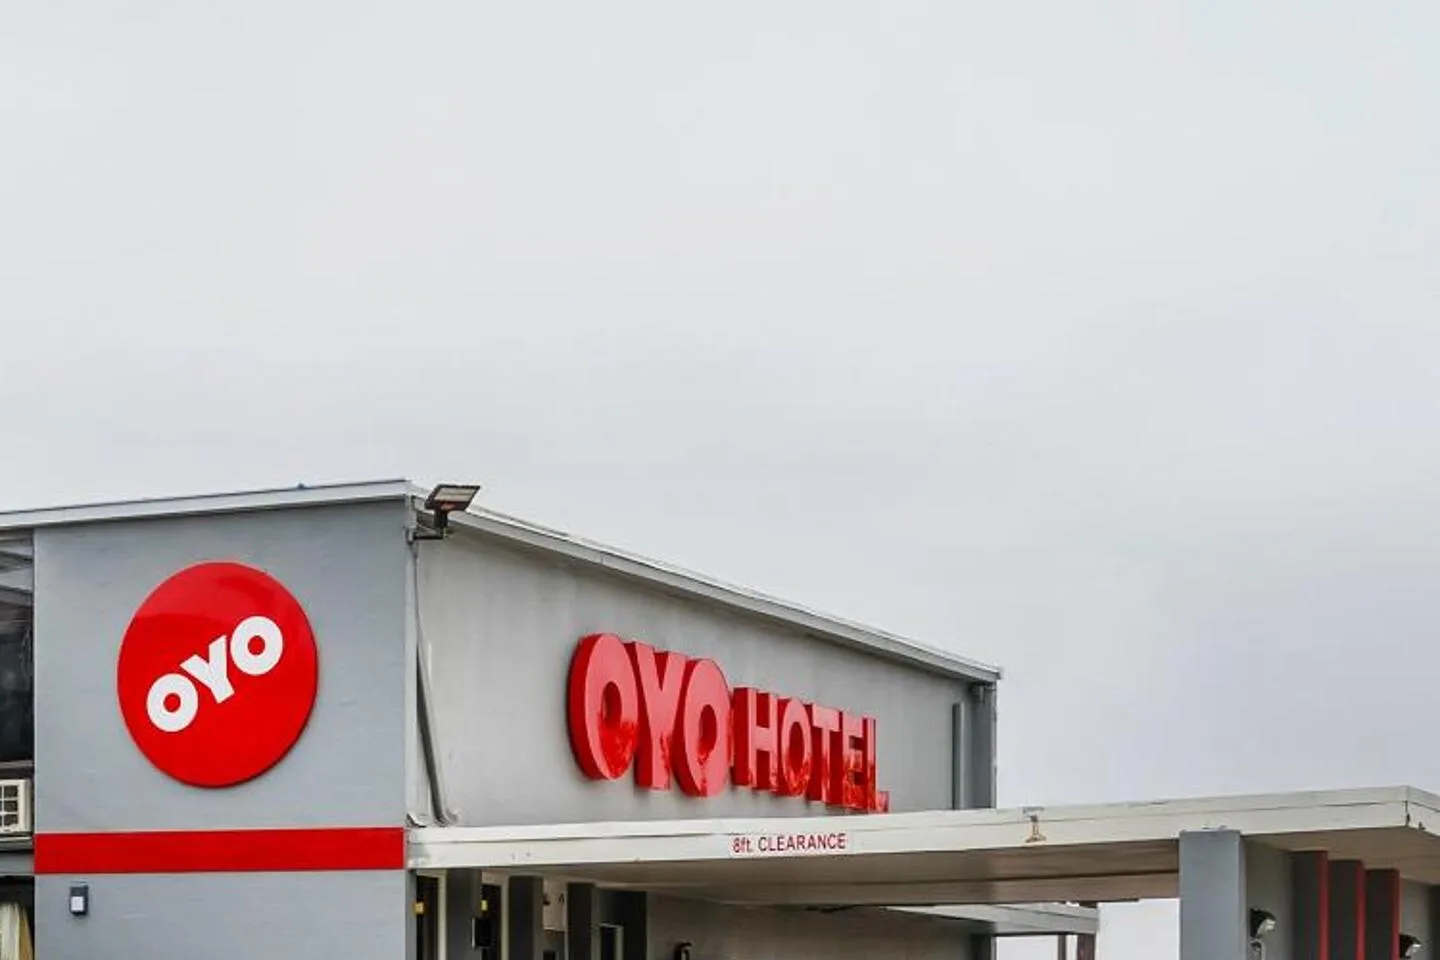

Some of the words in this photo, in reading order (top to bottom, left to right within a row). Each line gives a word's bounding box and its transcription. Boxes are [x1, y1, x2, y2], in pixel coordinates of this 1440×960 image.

[146, 616, 284, 733] OYO
[566, 632, 731, 797] OYO
[732, 687, 889, 814] HOTEL
[758, 833, 846, 852] CLEARANCE
